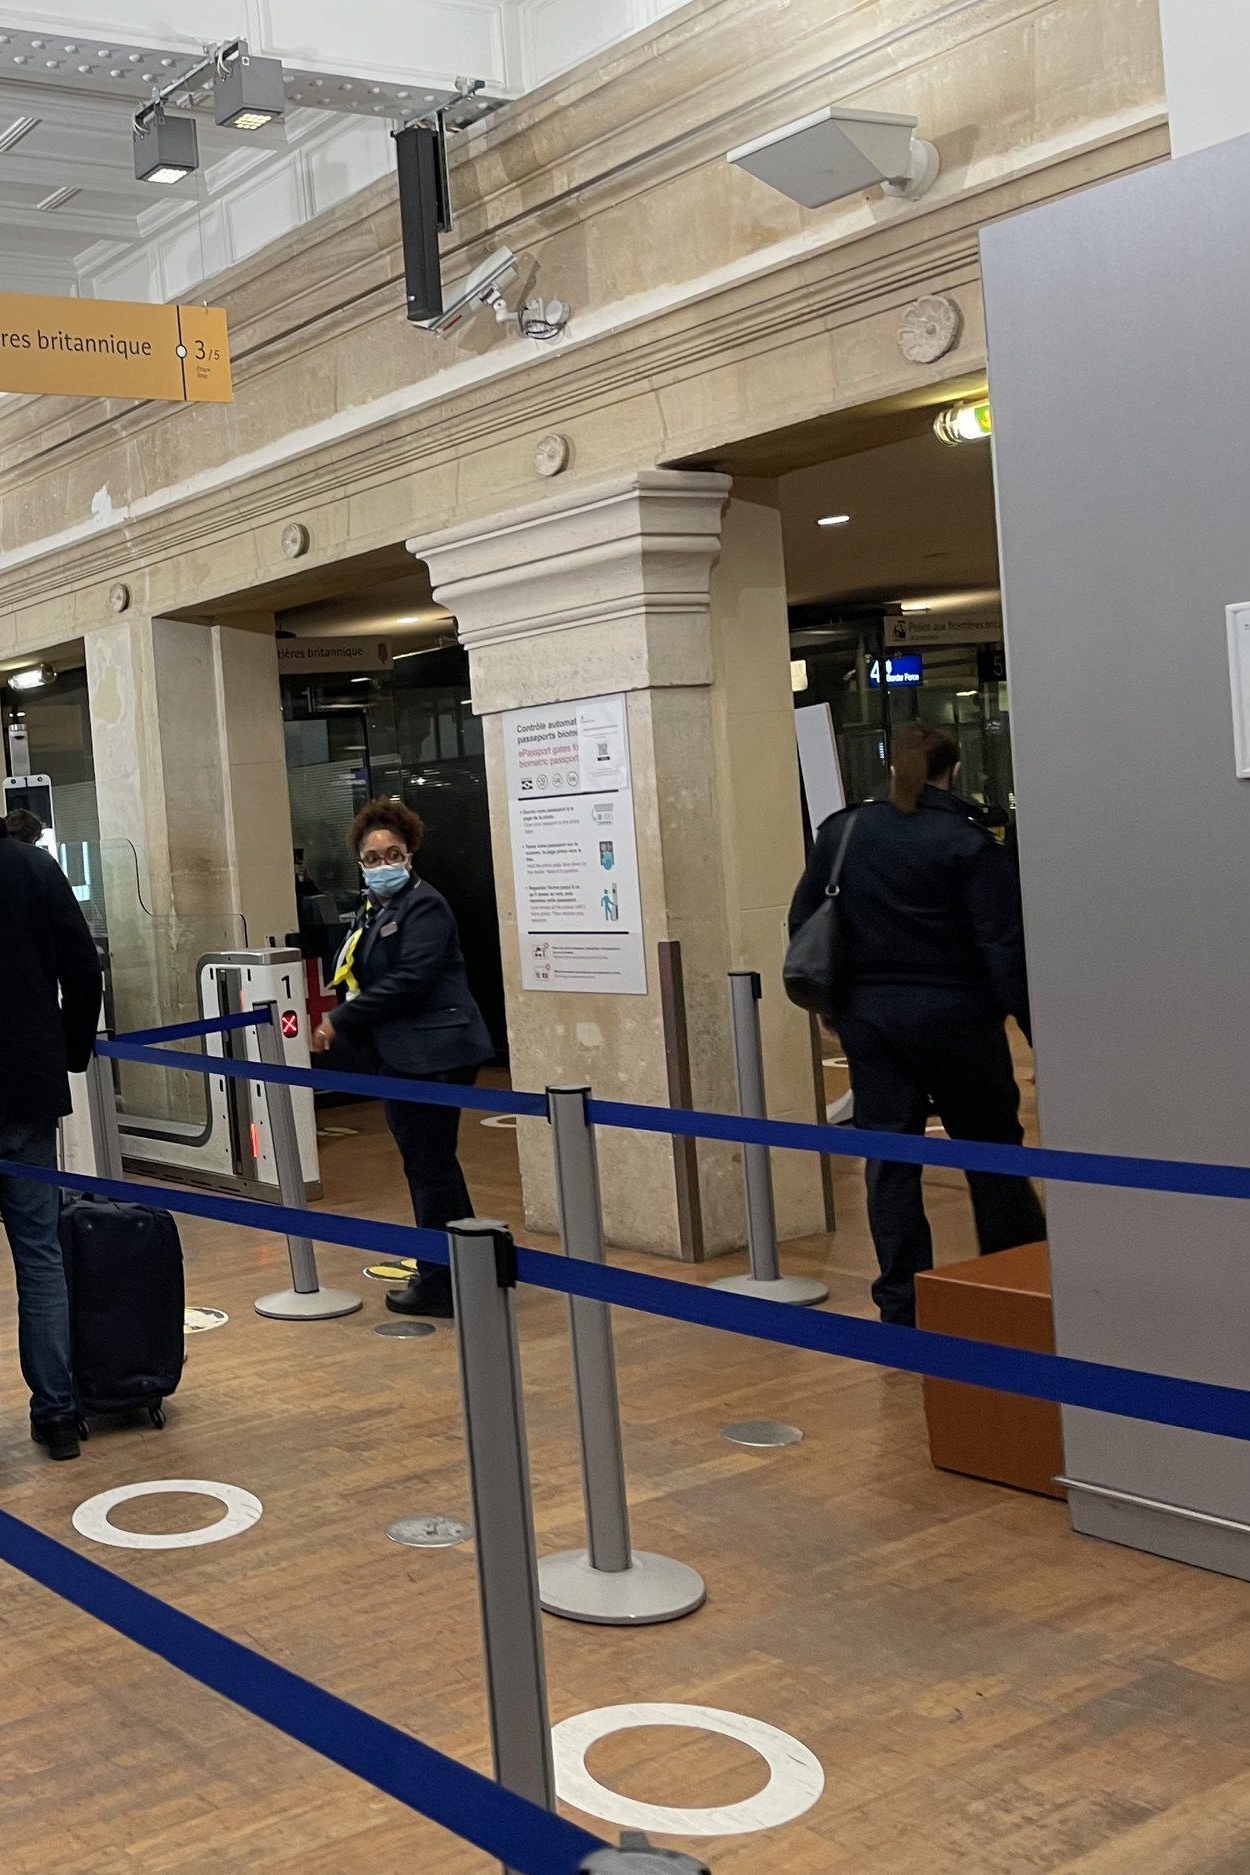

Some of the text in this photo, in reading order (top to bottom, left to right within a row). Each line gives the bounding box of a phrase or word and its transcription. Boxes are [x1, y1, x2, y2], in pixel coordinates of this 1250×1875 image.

[37, 329, 152, 360] britannique
[307, 646, 364, 659] britannique
[870, 660, 880, 684] 4
[516, 722, 546, 733] Contrôle
[517, 733, 556, 745] passeports
[23, 776, 29, 788] 1
[281, 975, 291, 999] 1
